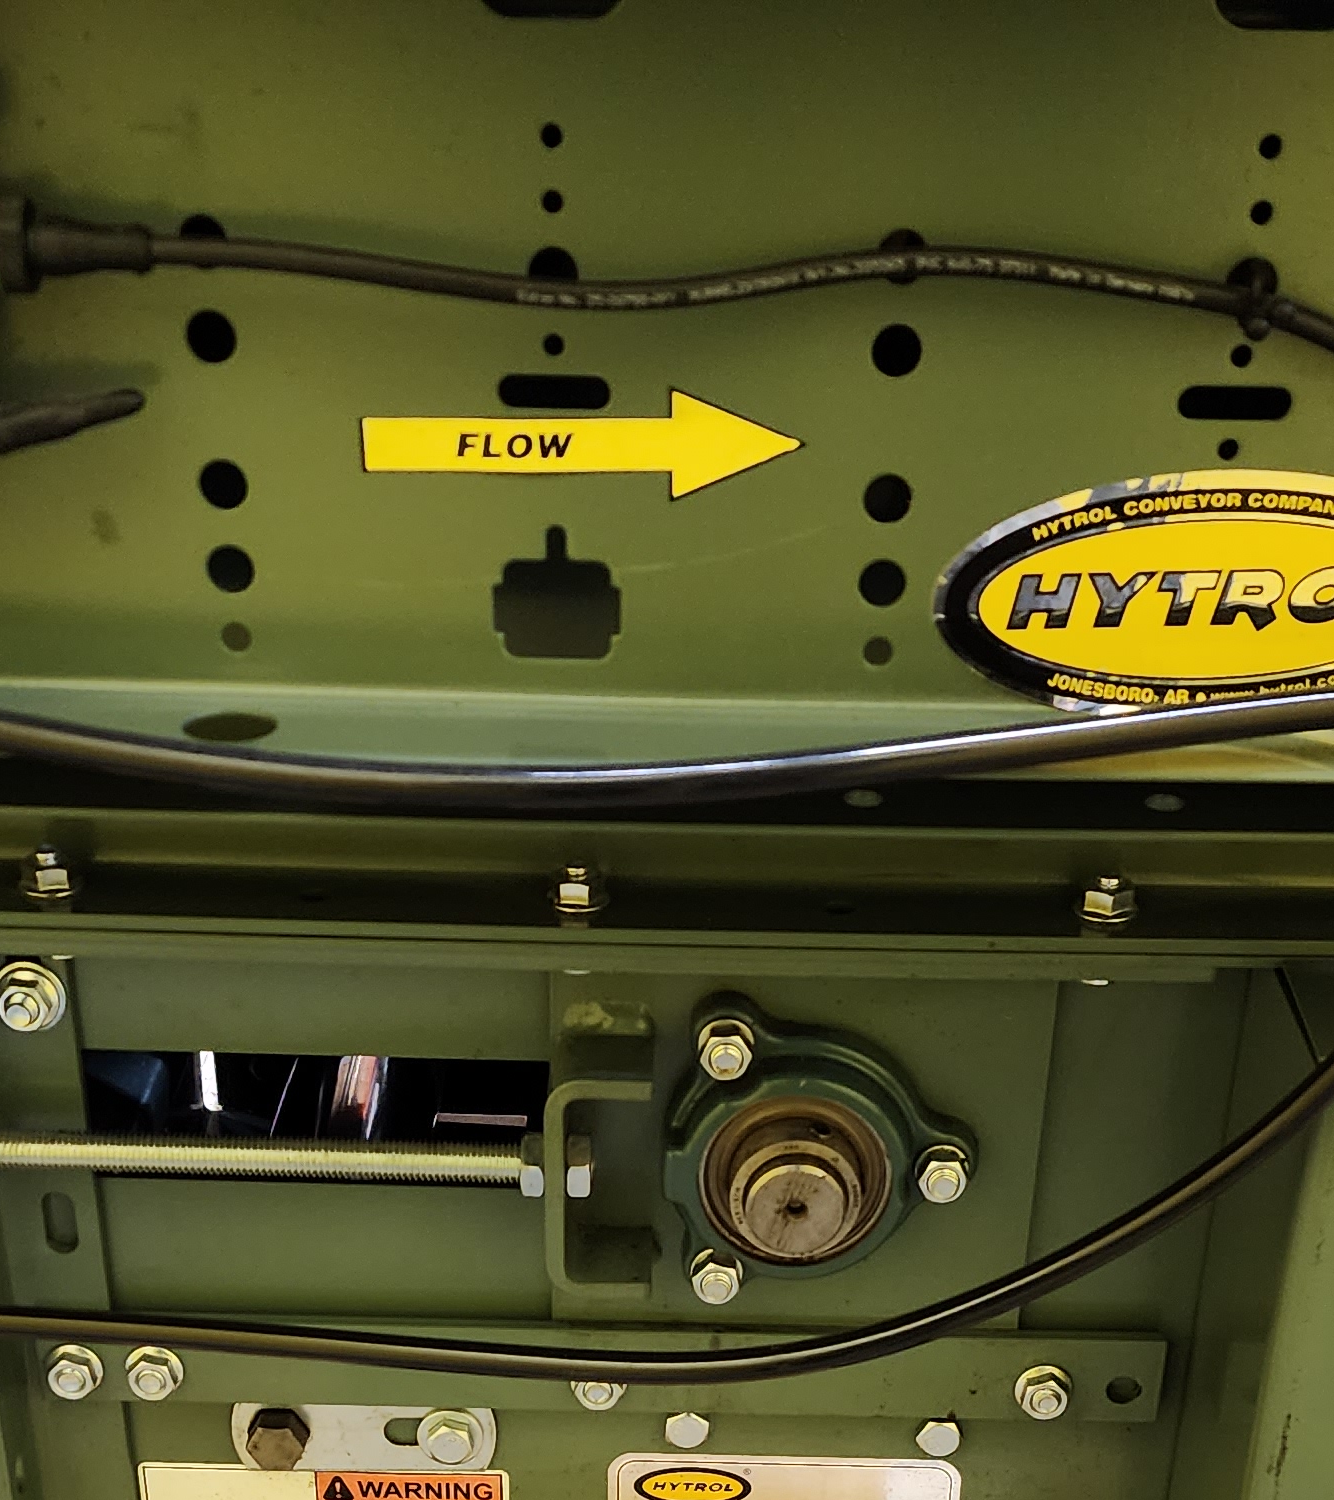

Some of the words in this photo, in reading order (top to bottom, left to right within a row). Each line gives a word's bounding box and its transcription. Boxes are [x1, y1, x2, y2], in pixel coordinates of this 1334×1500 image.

[457, 433, 572, 458] FLOW
[1032, 505, 1117, 541] HYTROL
[1124, 492, 1242, 516] CONVEYOR
[1047, 673, 1159, 703] JONESBORO,
[1163, 688, 1189, 704] AR
[357, 1480, 493, 1500] WARNING
[653, 1481, 734, 1492] HYTROL
